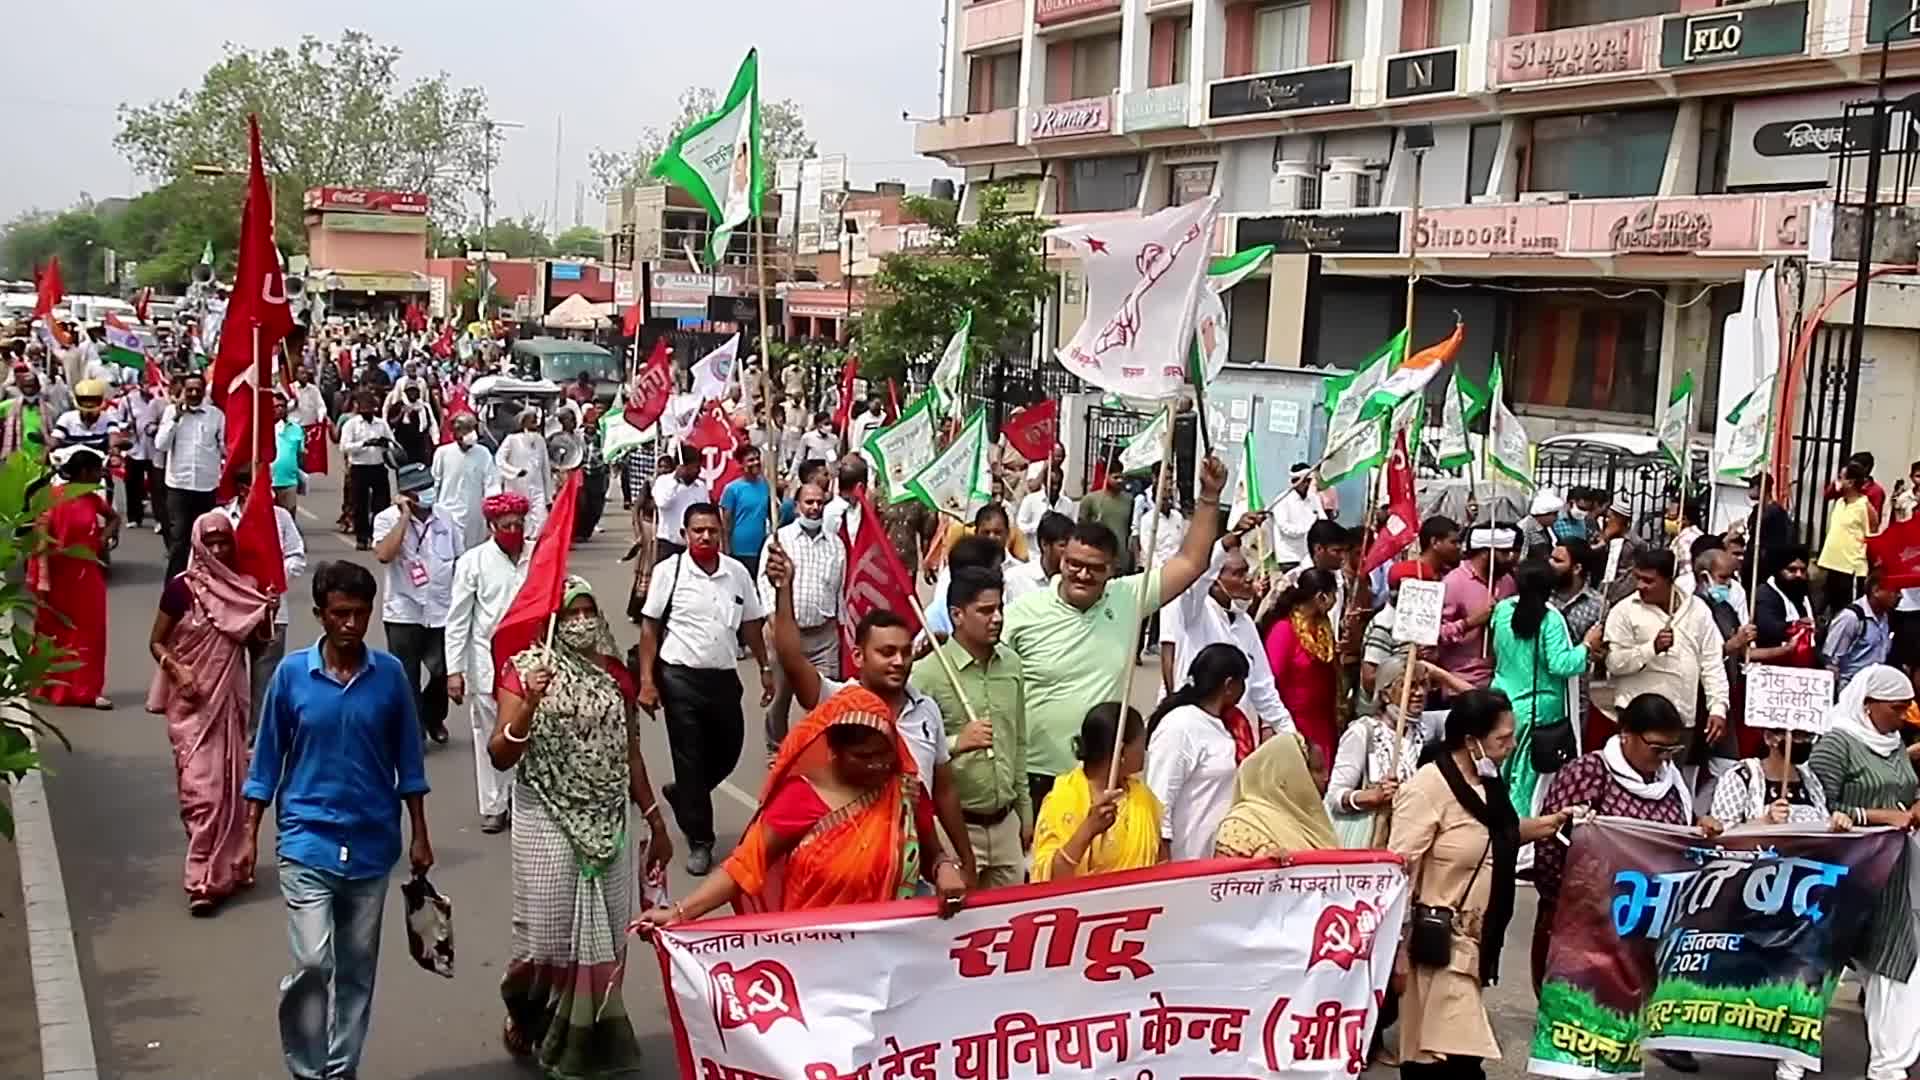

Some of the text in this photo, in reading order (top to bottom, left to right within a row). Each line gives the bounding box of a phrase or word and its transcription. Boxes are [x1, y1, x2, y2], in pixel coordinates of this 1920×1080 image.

[1693, 24, 1742, 54] FLO
[950, 906, 1163, 982] सीटू
[1669, 953, 1711, 973] 2021
[1723, 997, 1789, 1034] मोर्चा
